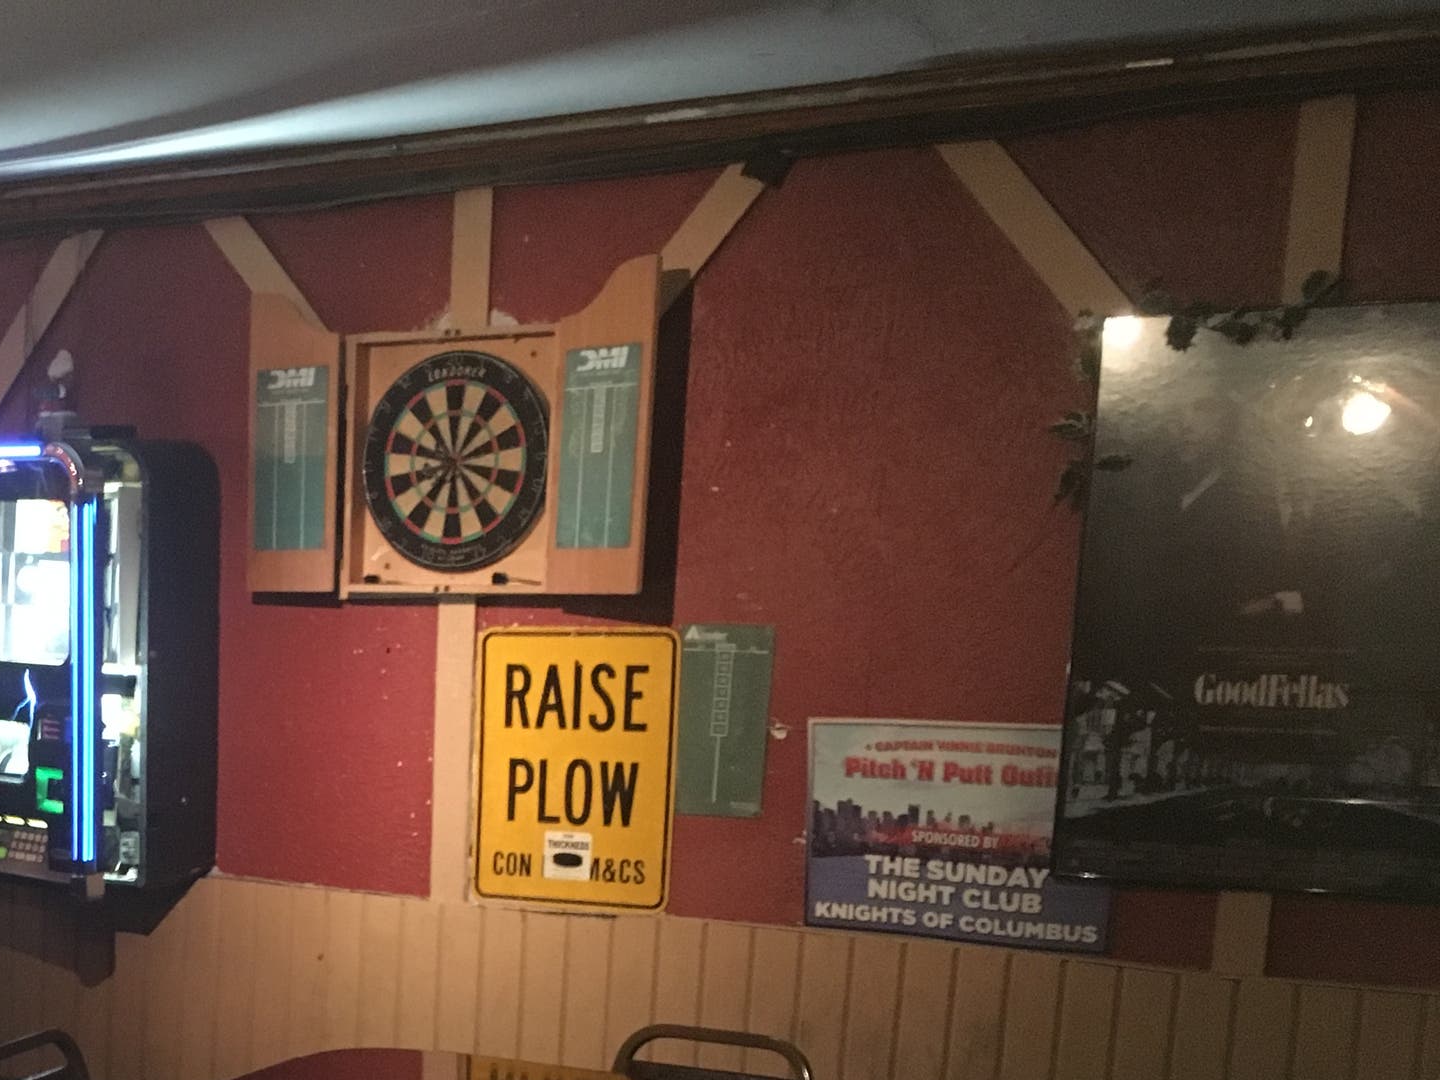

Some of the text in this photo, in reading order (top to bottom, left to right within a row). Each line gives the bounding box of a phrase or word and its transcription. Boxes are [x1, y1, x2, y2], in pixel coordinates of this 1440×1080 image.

[504, 660, 649, 732] RAISE
[1194, 674, 1350, 709] GoodFellas
[844, 757, 907, 780] Pitch
[942, 761, 993, 786] Putt
[507, 758, 638, 828] PLOW
[912, 830, 999, 850] SPONSORED BY
[864, 854, 920, 878] THE
[926, 859, 1049, 890] SUNDAY
[867, 878, 1043, 914] NIGHT CLUB
[814, 901, 1098, 944] KNIGHTS OF COLUMBUS
